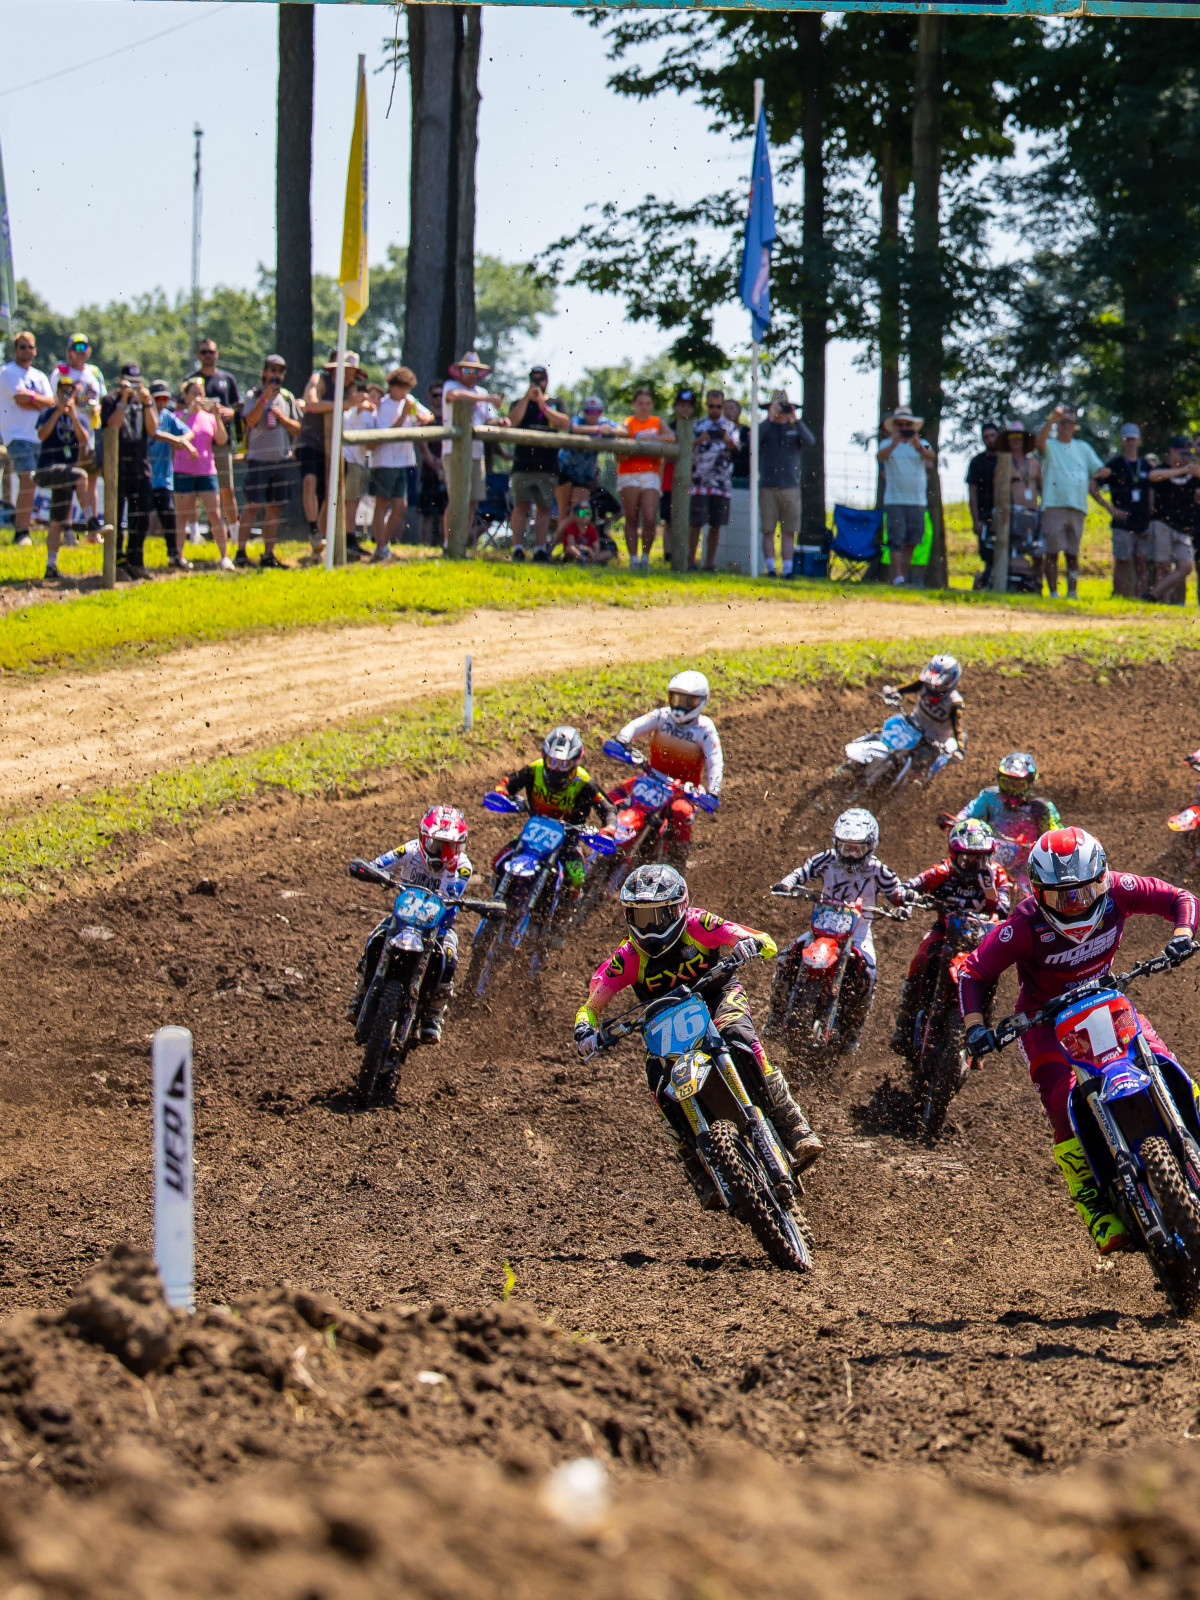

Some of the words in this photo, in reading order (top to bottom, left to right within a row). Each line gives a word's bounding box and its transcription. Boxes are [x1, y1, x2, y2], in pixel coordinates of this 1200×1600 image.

[523, 822, 563, 851] 379
[1044, 925, 1117, 964] MOOSE
[1070, 939, 1115, 967] OFFROAD
[645, 954, 708, 992] FXR
[1150, 961, 1166, 972] ASV
[651, 1004, 705, 1058] 76
[1000, 1030, 1016, 1045] ASV
[1074, 1004, 1119, 1057] 1
[1111, 1081, 1140, 1097] YAMAHA
[1103, 1116, 1117, 1146] racing
[164, 1102, 186, 1194] UFO
